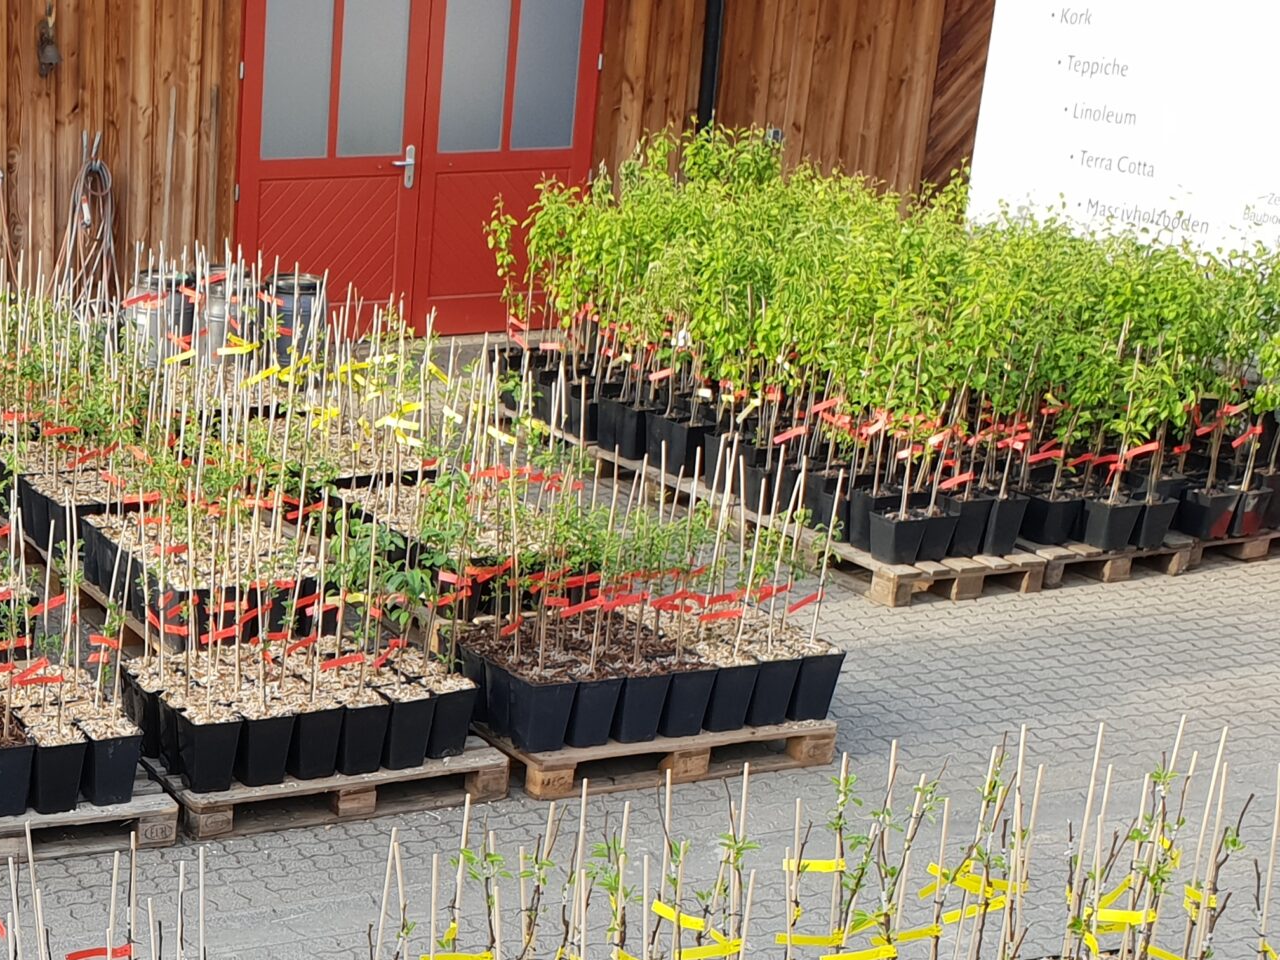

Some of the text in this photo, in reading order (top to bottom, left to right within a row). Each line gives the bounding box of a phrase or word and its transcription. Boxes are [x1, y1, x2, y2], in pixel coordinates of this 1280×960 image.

[1060, 8, 1092, 25] Kork
[1067, 55, 1129, 78] Teppiche
[1072, 102, 1137, 125] Linoleum
[1080, 151, 1155, 178] Terra Cotta
